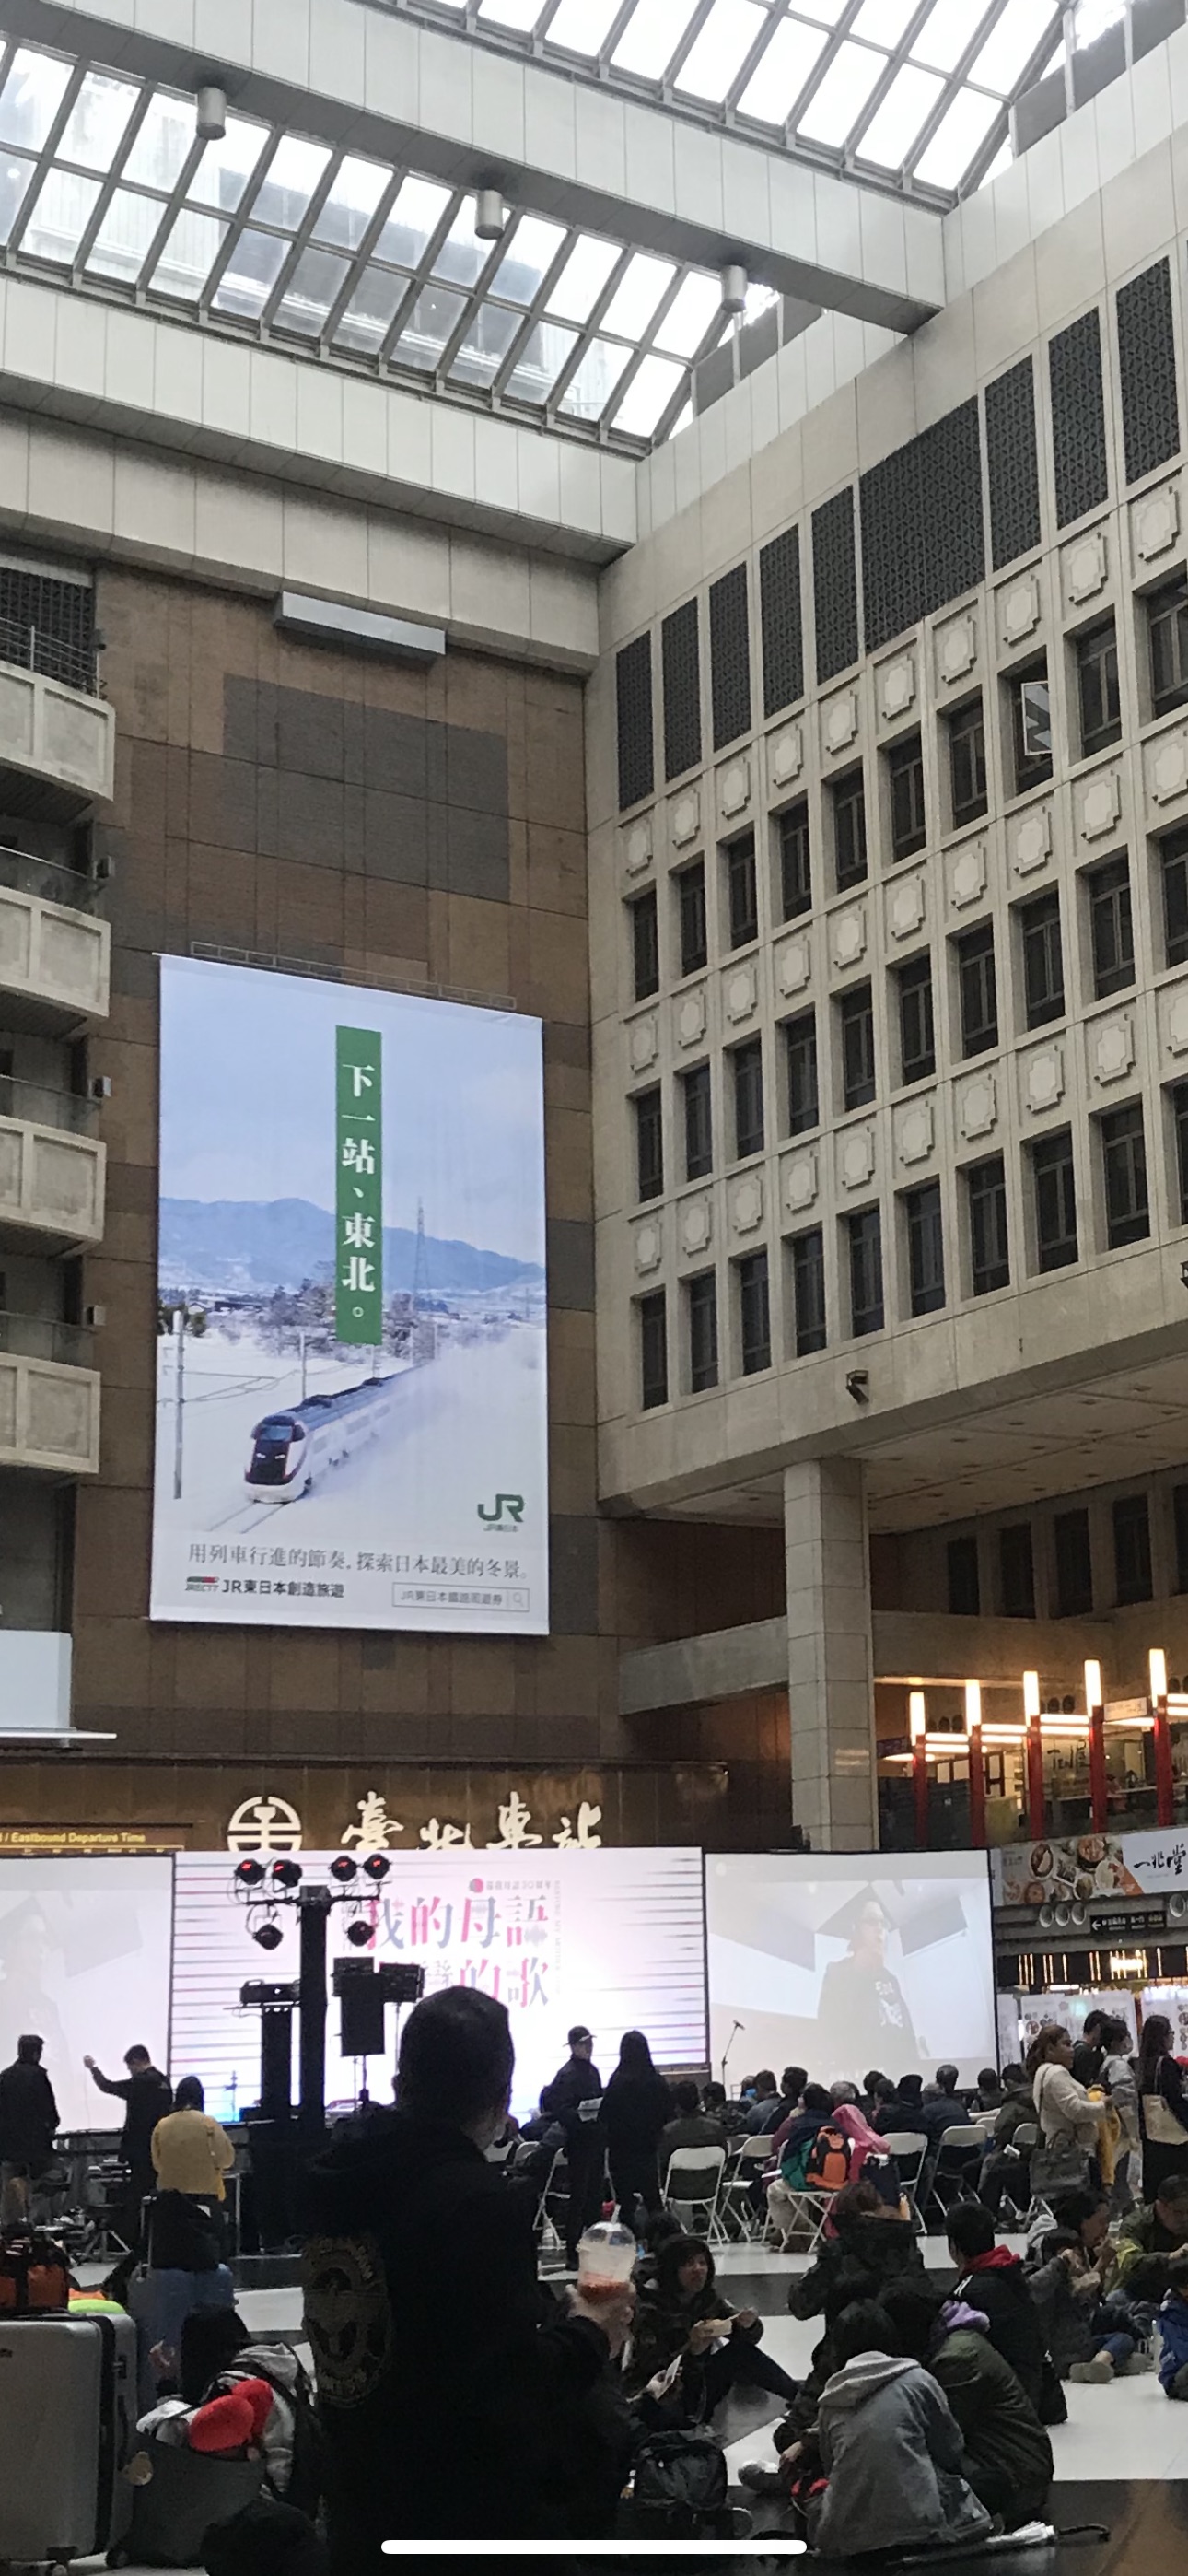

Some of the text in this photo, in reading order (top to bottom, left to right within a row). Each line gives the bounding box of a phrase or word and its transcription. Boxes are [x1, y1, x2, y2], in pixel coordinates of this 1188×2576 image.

[341, 1063, 376, 1318] 下一站、東北。
[477, 1493, 524, 1523] JR
[11, 1832, 66, 1843] Eastbound
[68, 1832, 119, 1844] Departure
[121, 1833, 146, 1843] Time
[366, 1895, 549, 1950] 我的母語
